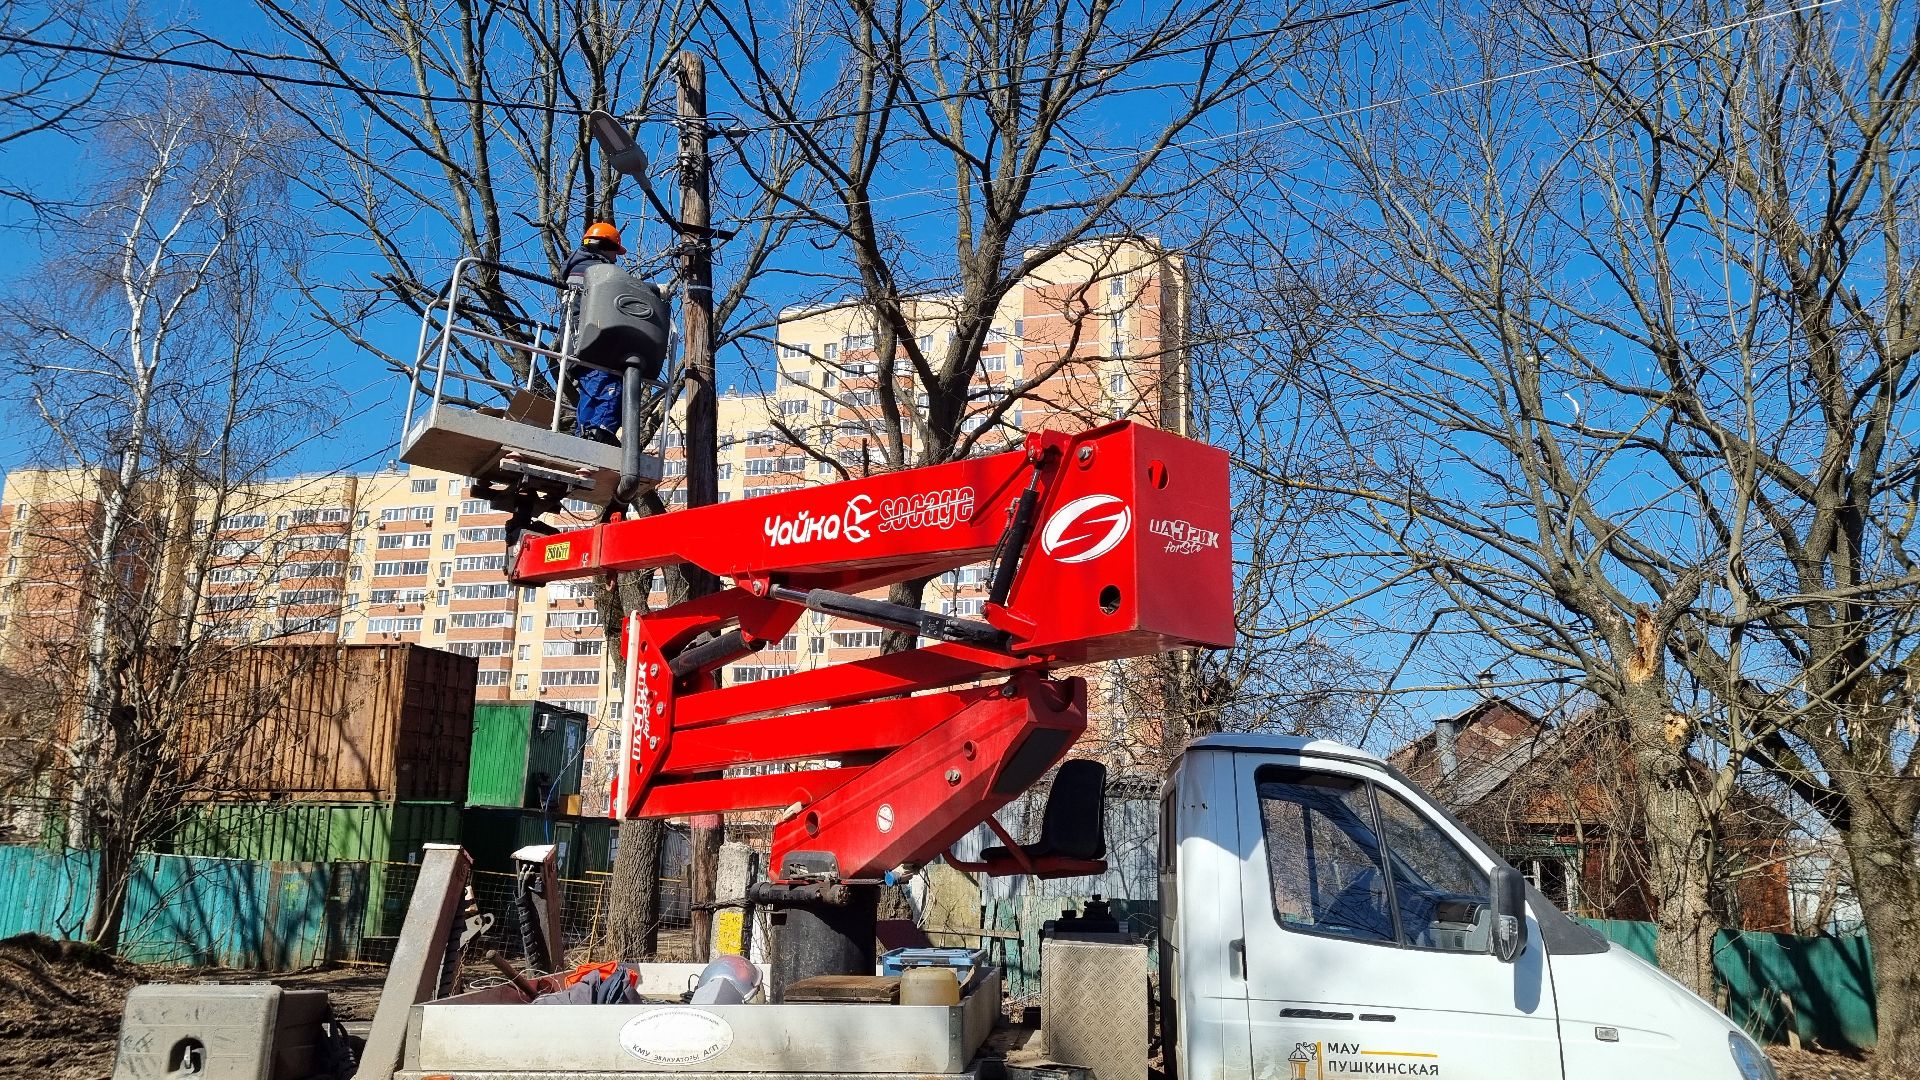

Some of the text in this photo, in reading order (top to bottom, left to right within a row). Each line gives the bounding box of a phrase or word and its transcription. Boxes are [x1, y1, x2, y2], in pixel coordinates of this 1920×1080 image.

[764, 510, 840, 547] Чайка
[632, 1044, 651, 1057] КМУ
[703, 1043, 719, 1057] АГП
[1328, 1042, 1360, 1054] МАУ
[1328, 1060, 1439, 1076] ПУШКИНСКАЯ
